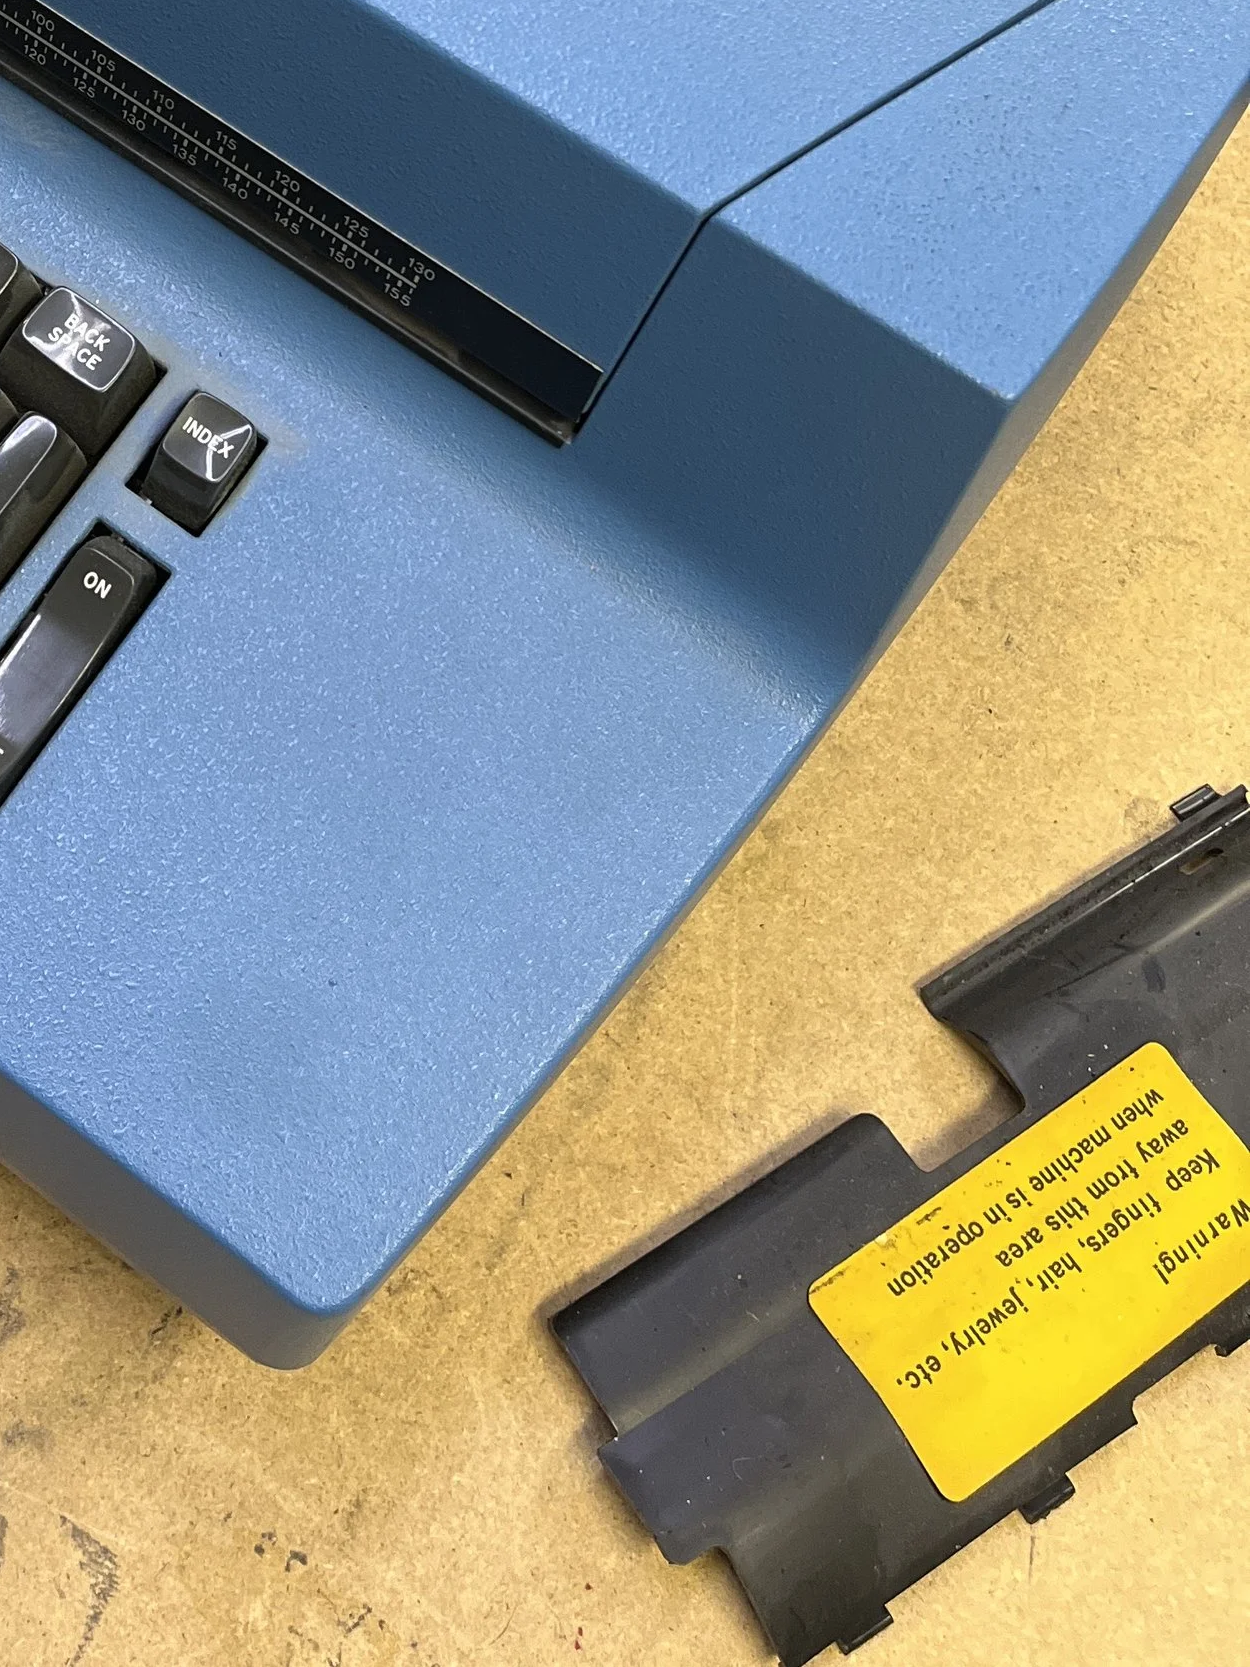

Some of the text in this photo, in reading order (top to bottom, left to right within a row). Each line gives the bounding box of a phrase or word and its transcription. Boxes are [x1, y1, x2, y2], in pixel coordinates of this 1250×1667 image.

[23, 44, 47, 66] 120
[72, 77, 96, 99] 125
[121, 109, 146, 132] 130
[171, 144, 198, 167] 135
[222, 176, 249, 201] 140
[273, 211, 300, 236] 145
[328, 247, 356, 271] 150
[383, 283, 411, 308] 155
[30, 9, 55, 32] 100
[91, 49, 116, 72] 105
[152, 89, 175, 110] 110
[215, 130, 238, 152] 115
[274, 169, 300, 193] 120
[343, 215, 370, 239] 125
[408, 256, 436, 282] 130
[47, 326, 103, 371] SPACE
[64, 313, 111, 352] BACK
[181, 416, 235, 459] INDEX
[82, 570, 113, 600] ON
[886, 1087, 1165, 1298] when machine is in operation
[994, 1119, 1190, 1268] away from this area
[1152, 1198, 1250, 1286] Warning!
[895, 1147, 1221, 1391] Keep fingers, hair, jewelry, etc.
